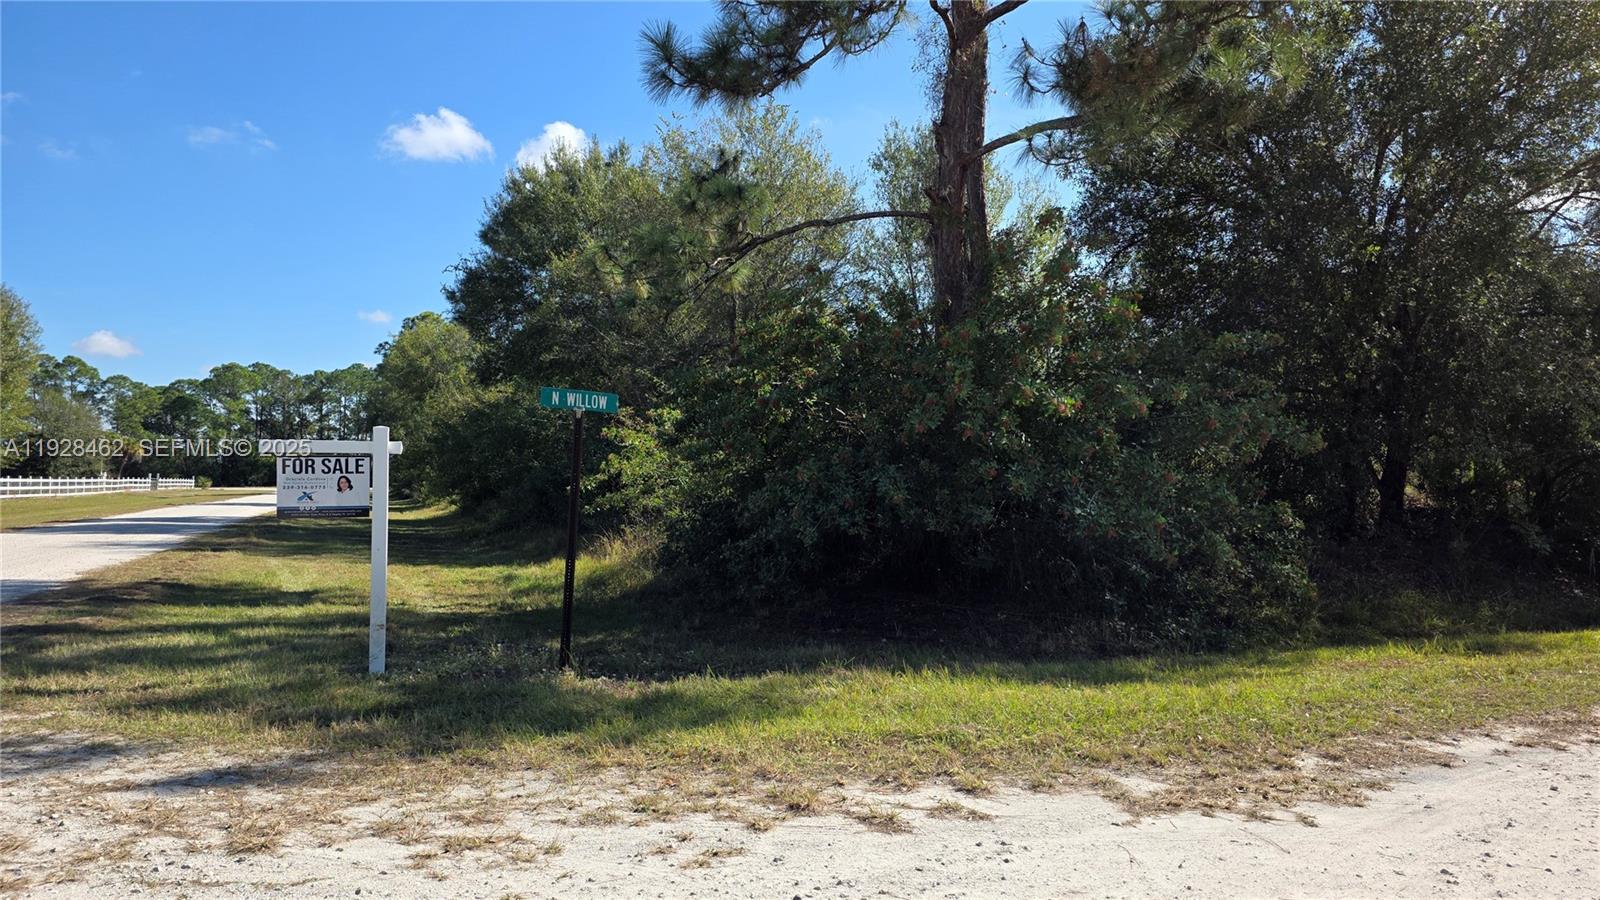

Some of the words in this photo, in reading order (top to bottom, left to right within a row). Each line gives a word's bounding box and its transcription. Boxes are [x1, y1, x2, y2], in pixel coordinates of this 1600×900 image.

[552, 391, 559, 405] N
[567, 393, 607, 409] WILLOW
[282, 458, 315, 474] FOR
[321, 458, 365, 474] SALE
